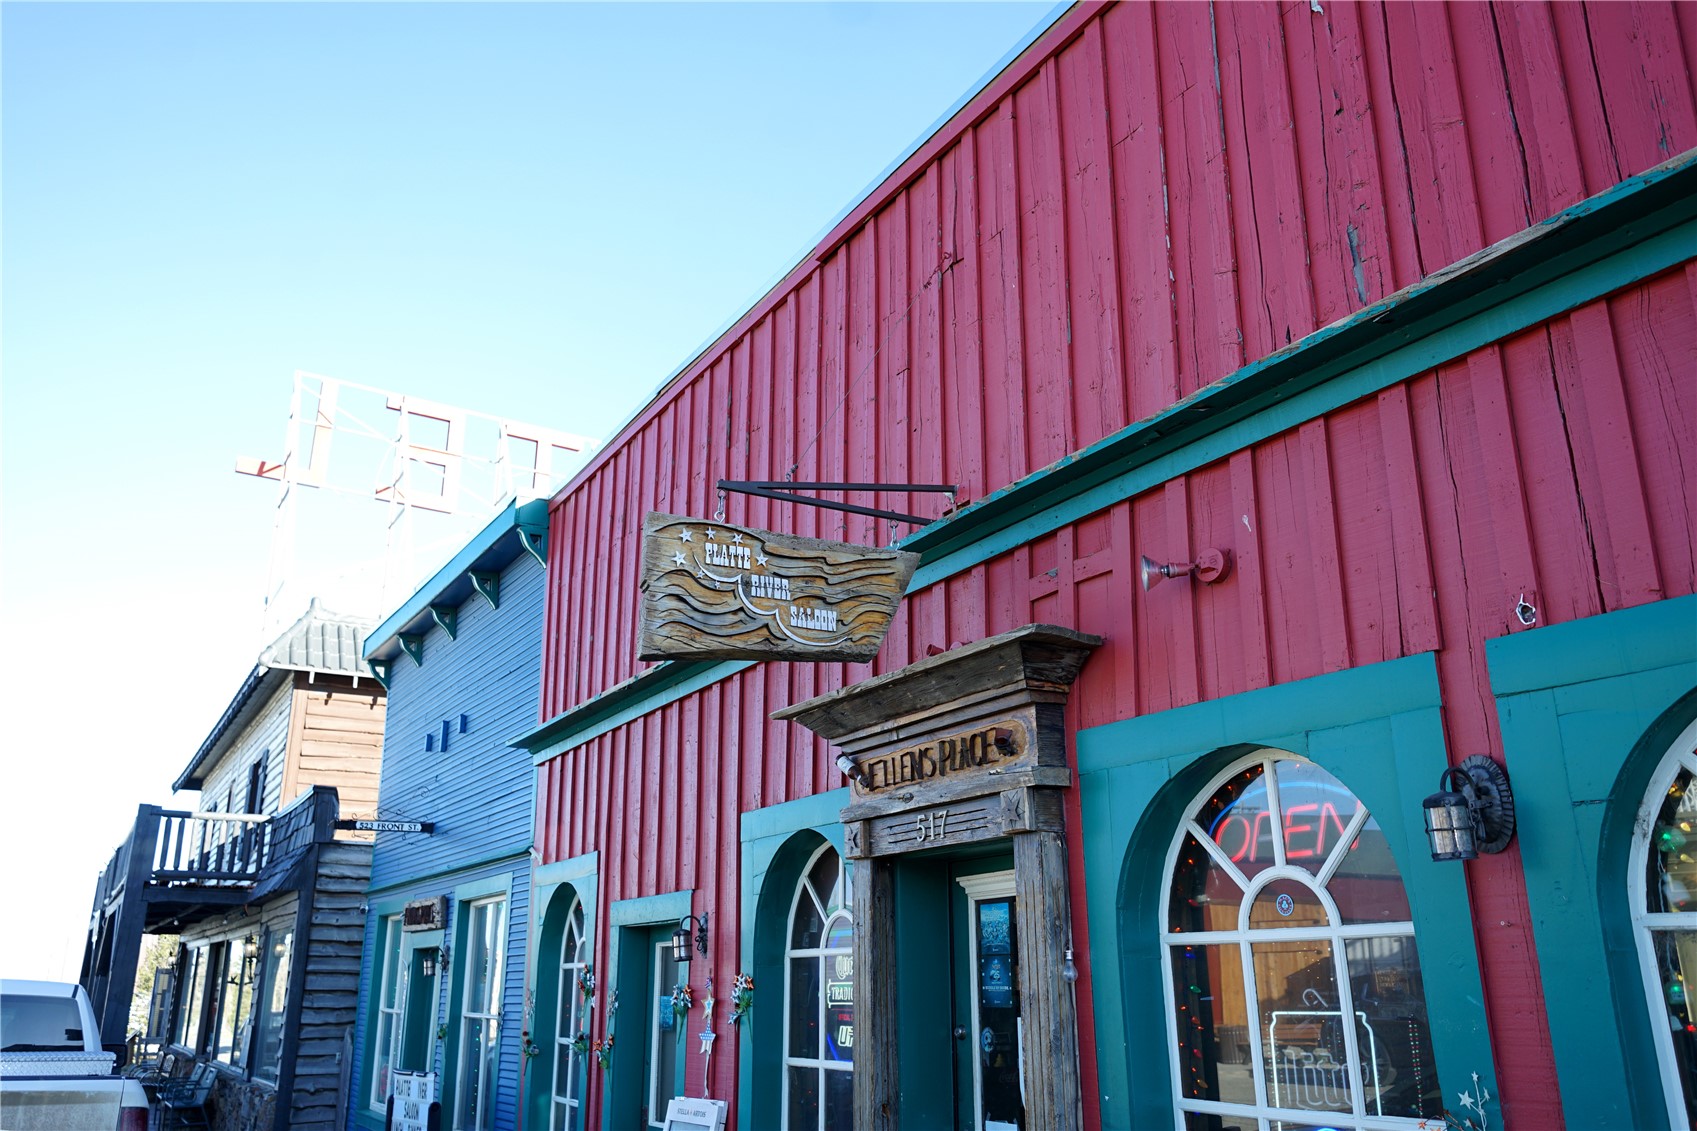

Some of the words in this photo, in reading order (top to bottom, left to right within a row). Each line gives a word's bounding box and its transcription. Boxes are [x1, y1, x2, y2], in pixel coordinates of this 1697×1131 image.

[705, 542, 751, 570] PLATTE
[751, 574, 791, 600] RIVER
[790, 605, 837, 632] SALOON
[938, 727, 1000, 776] PLACE
[360, 822, 374, 830] 523
[377, 822, 405, 832] FRONT
[916, 810, 949, 842] 517
